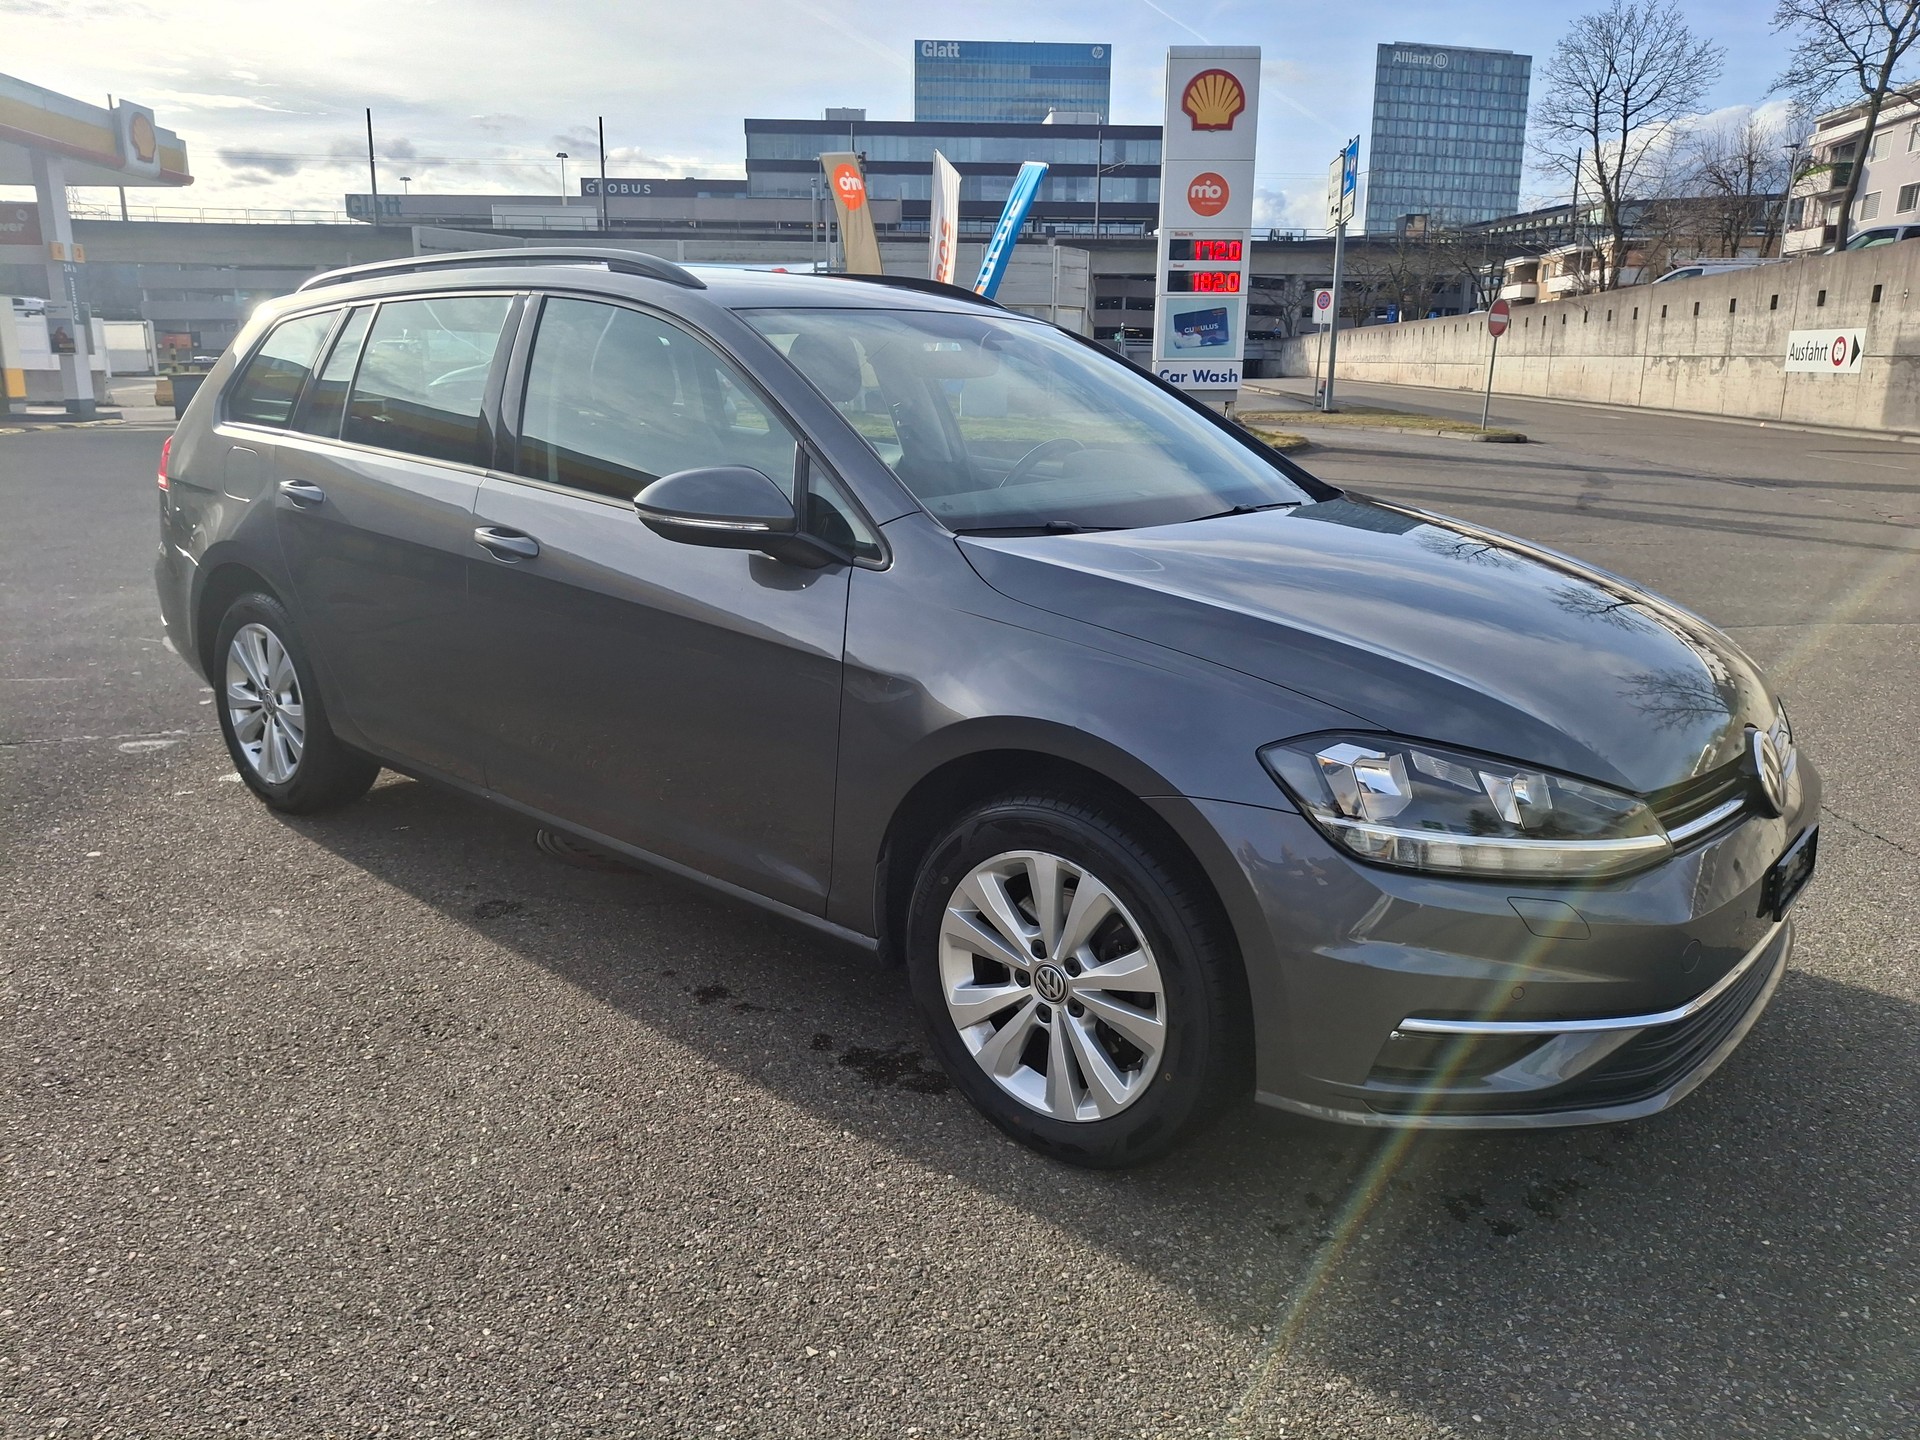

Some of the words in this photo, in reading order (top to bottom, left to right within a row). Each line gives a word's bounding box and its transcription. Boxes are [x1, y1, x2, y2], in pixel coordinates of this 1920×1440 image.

[921, 41, 960, 58] Glatt
[1393, 51, 1433, 65] Allianz
[1190, 180, 1222, 199] mio
[1195, 240, 1242, 261] 172.0
[1193, 272, 1240, 292] 182.0
[1184, 323, 1219, 333] CUMULUS
[1788, 340, 1828, 361] Ausfahrt
[1159, 369, 1187, 382] Car
[1192, 368, 1238, 383] Wash
